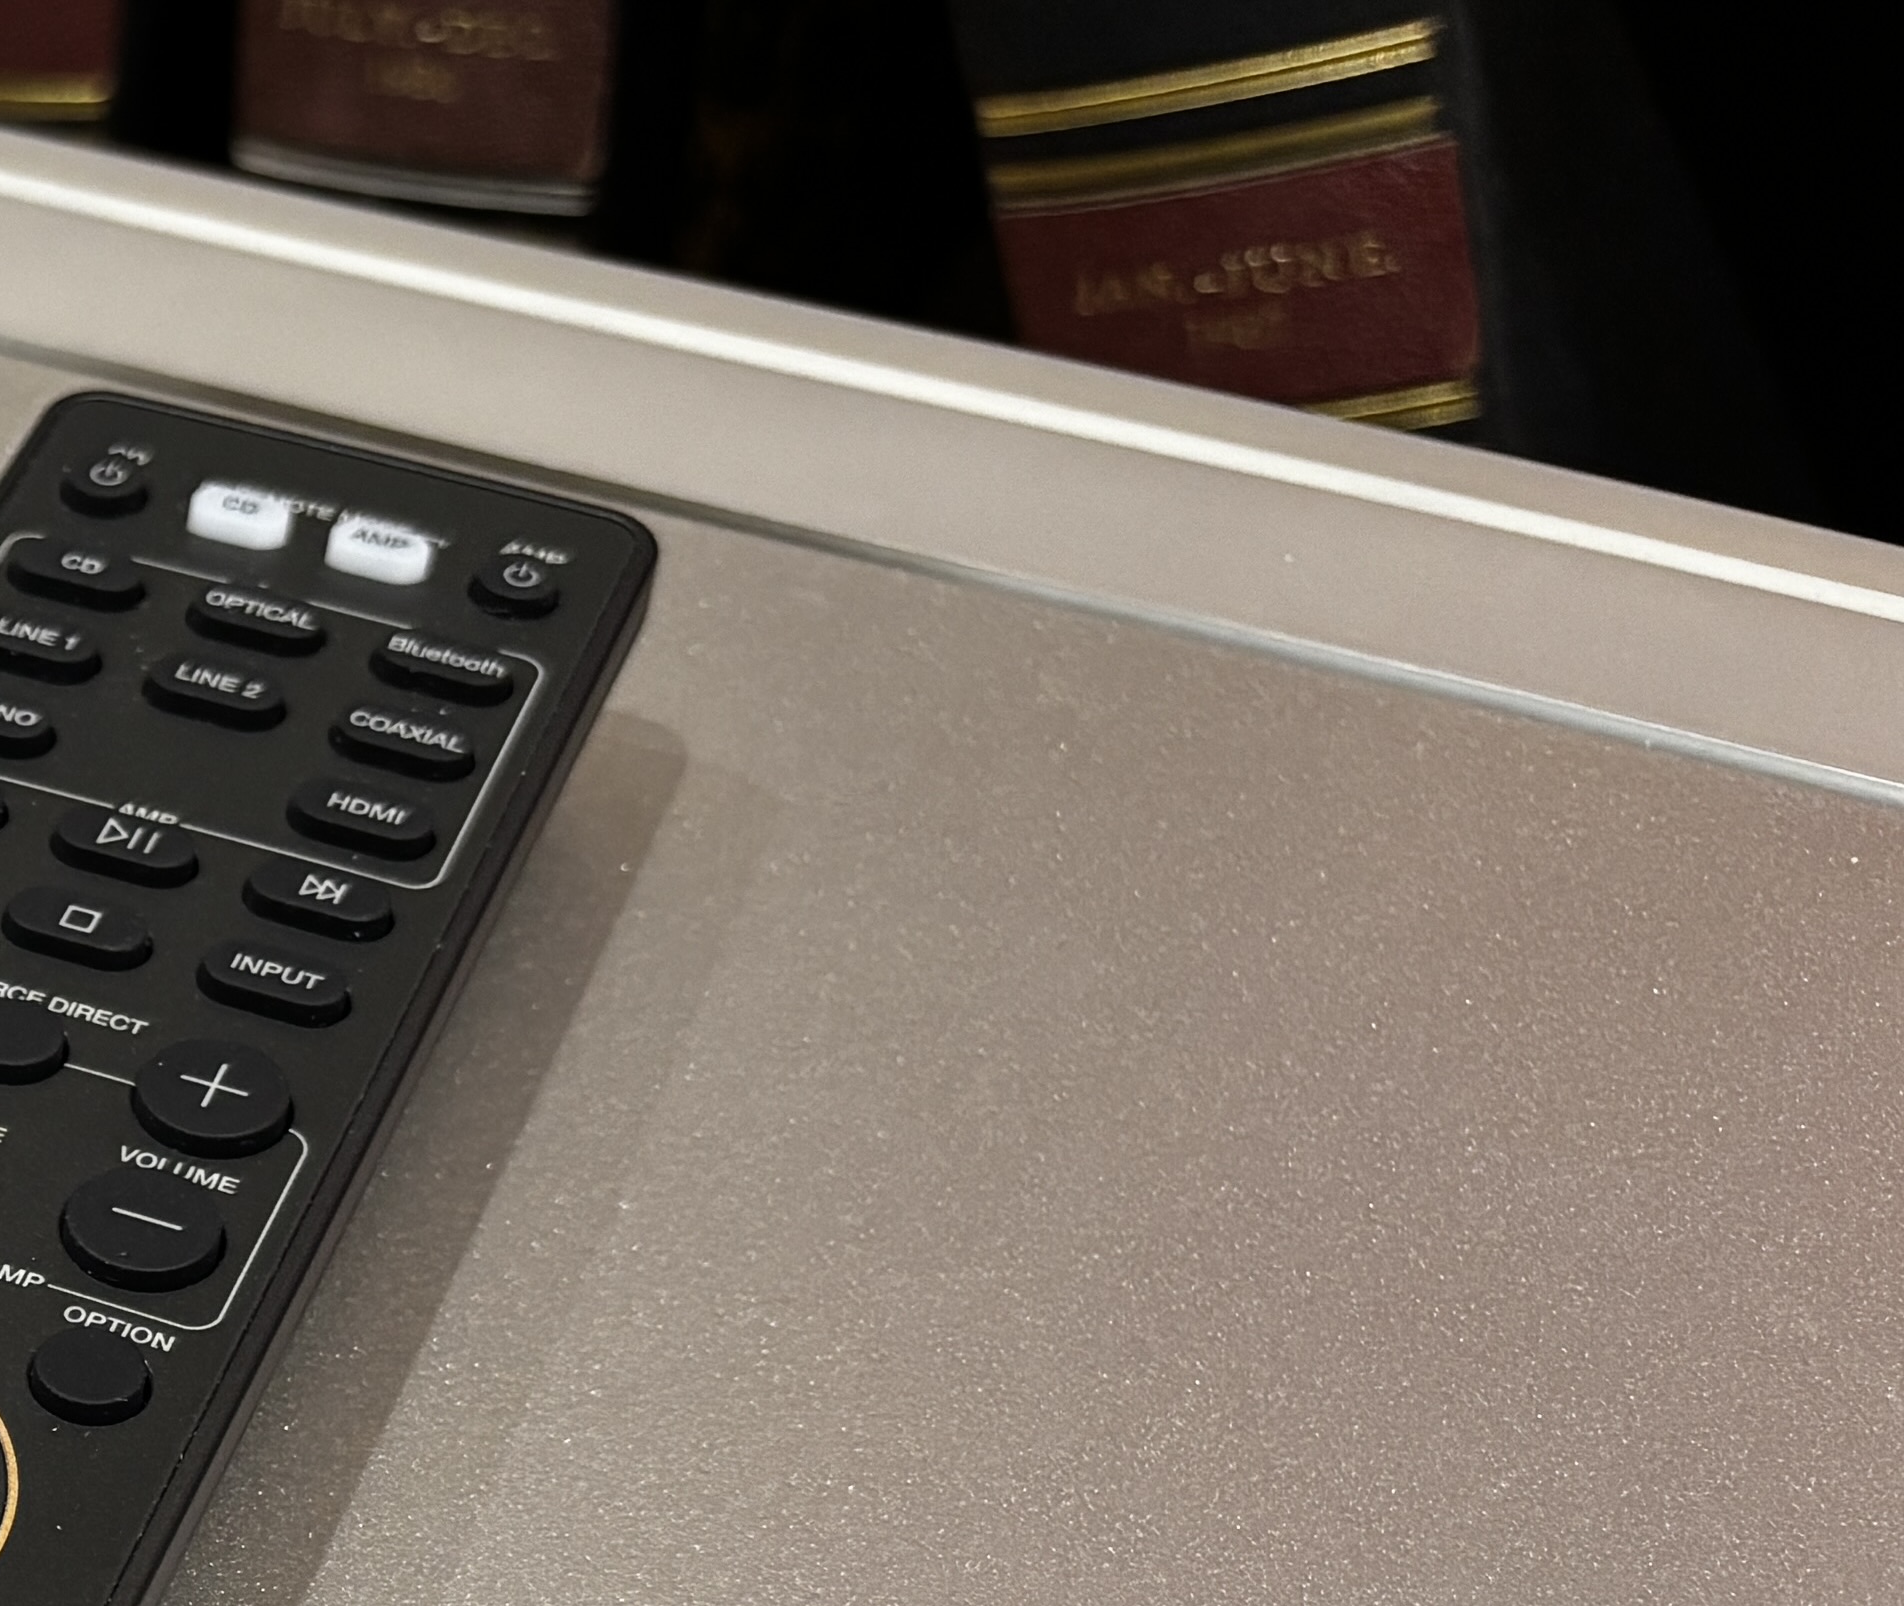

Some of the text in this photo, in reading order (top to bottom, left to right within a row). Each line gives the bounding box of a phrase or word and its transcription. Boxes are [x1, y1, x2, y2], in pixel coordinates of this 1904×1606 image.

[351, 528, 409, 549] AMP
[61, 553, 106, 574] CD
[204, 590, 318, 632] OPTICAL
[63, 632, 82, 652] 1
[387, 635, 505, 678] Bluetooth
[174, 663, 263, 700] LINE 2
[349, 709, 466, 753] COAXIAL
[326, 791, 407, 826] HDMI
[229, 952, 326, 991] INPUT
[47, 996, 150, 1035] DIRECT
[62, 1305, 176, 1352] OPTION
